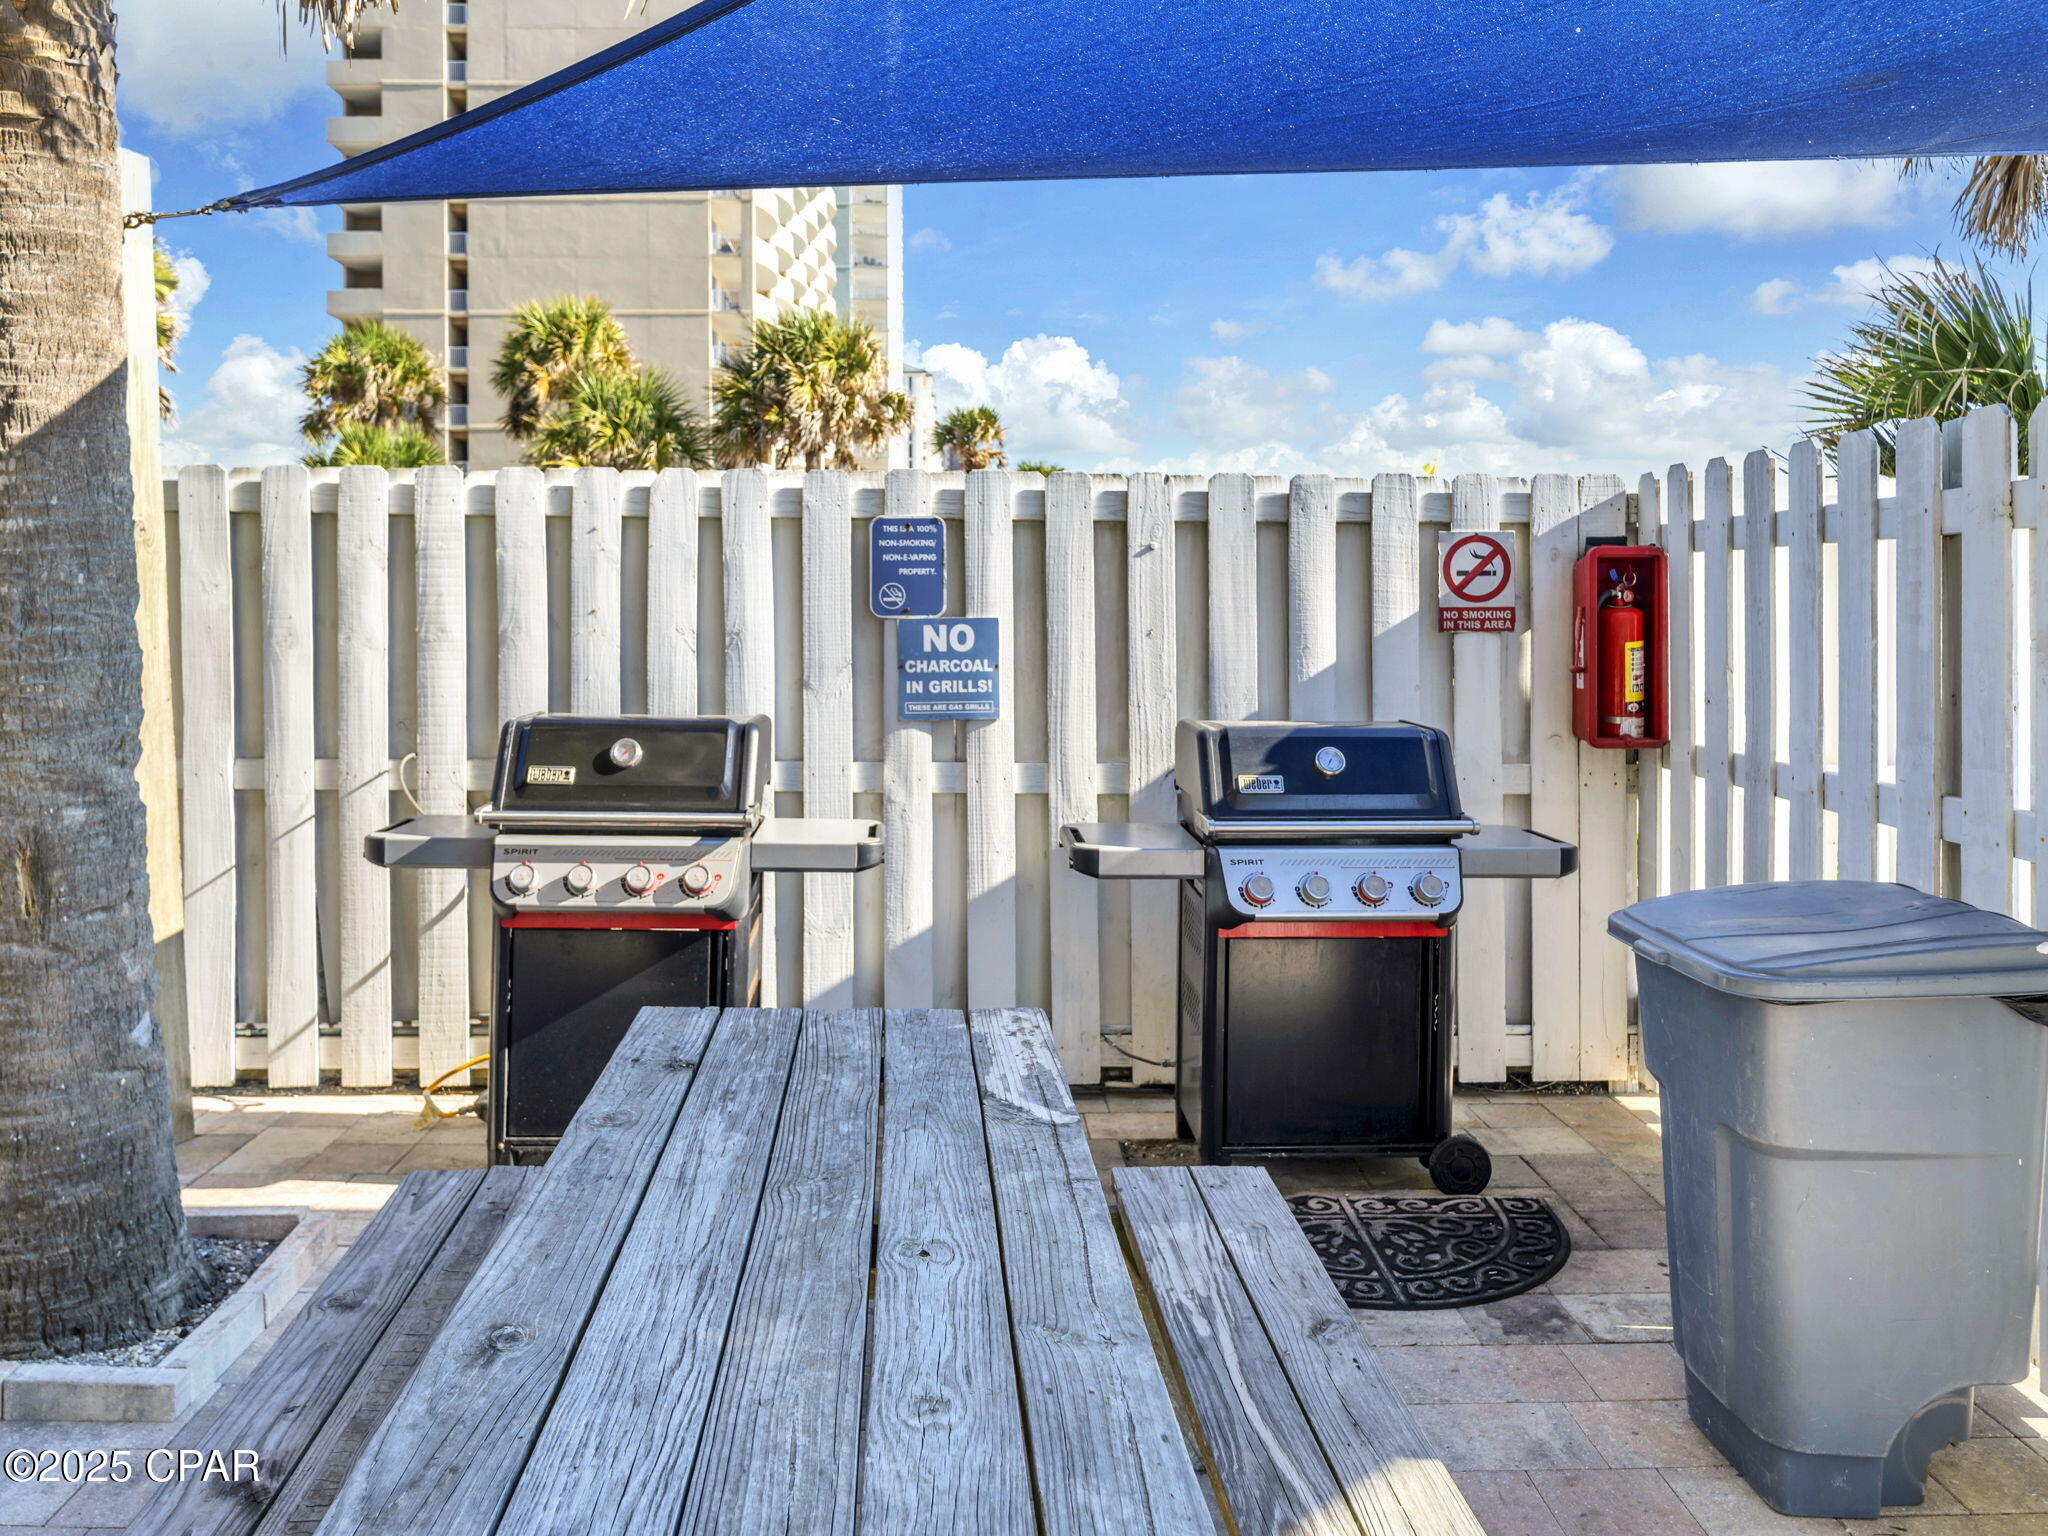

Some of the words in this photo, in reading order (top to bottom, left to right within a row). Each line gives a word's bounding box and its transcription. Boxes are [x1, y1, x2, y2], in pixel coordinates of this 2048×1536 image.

[882, 525, 898, 533] THIS
[916, 525, 937, 533] 100%
[882, 553, 937, 561] NON-E-VAPING
[898, 567, 937, 576] PROPERTY.
[1443, 610, 1459, 620] NO
[1462, 610, 1512, 619] SMOKING
[1443, 621, 1454, 629] IN
[1457, 621, 1481, 629] THIS
[1483, 620, 1512, 629] AREA
[923, 624, 975, 652] NO
[905, 659, 993, 673] CHARCOAL
[906, 680, 923, 694] IN
[928, 680, 993, 693] GRILLS!
[964, 703, 990, 711] GRILLS
